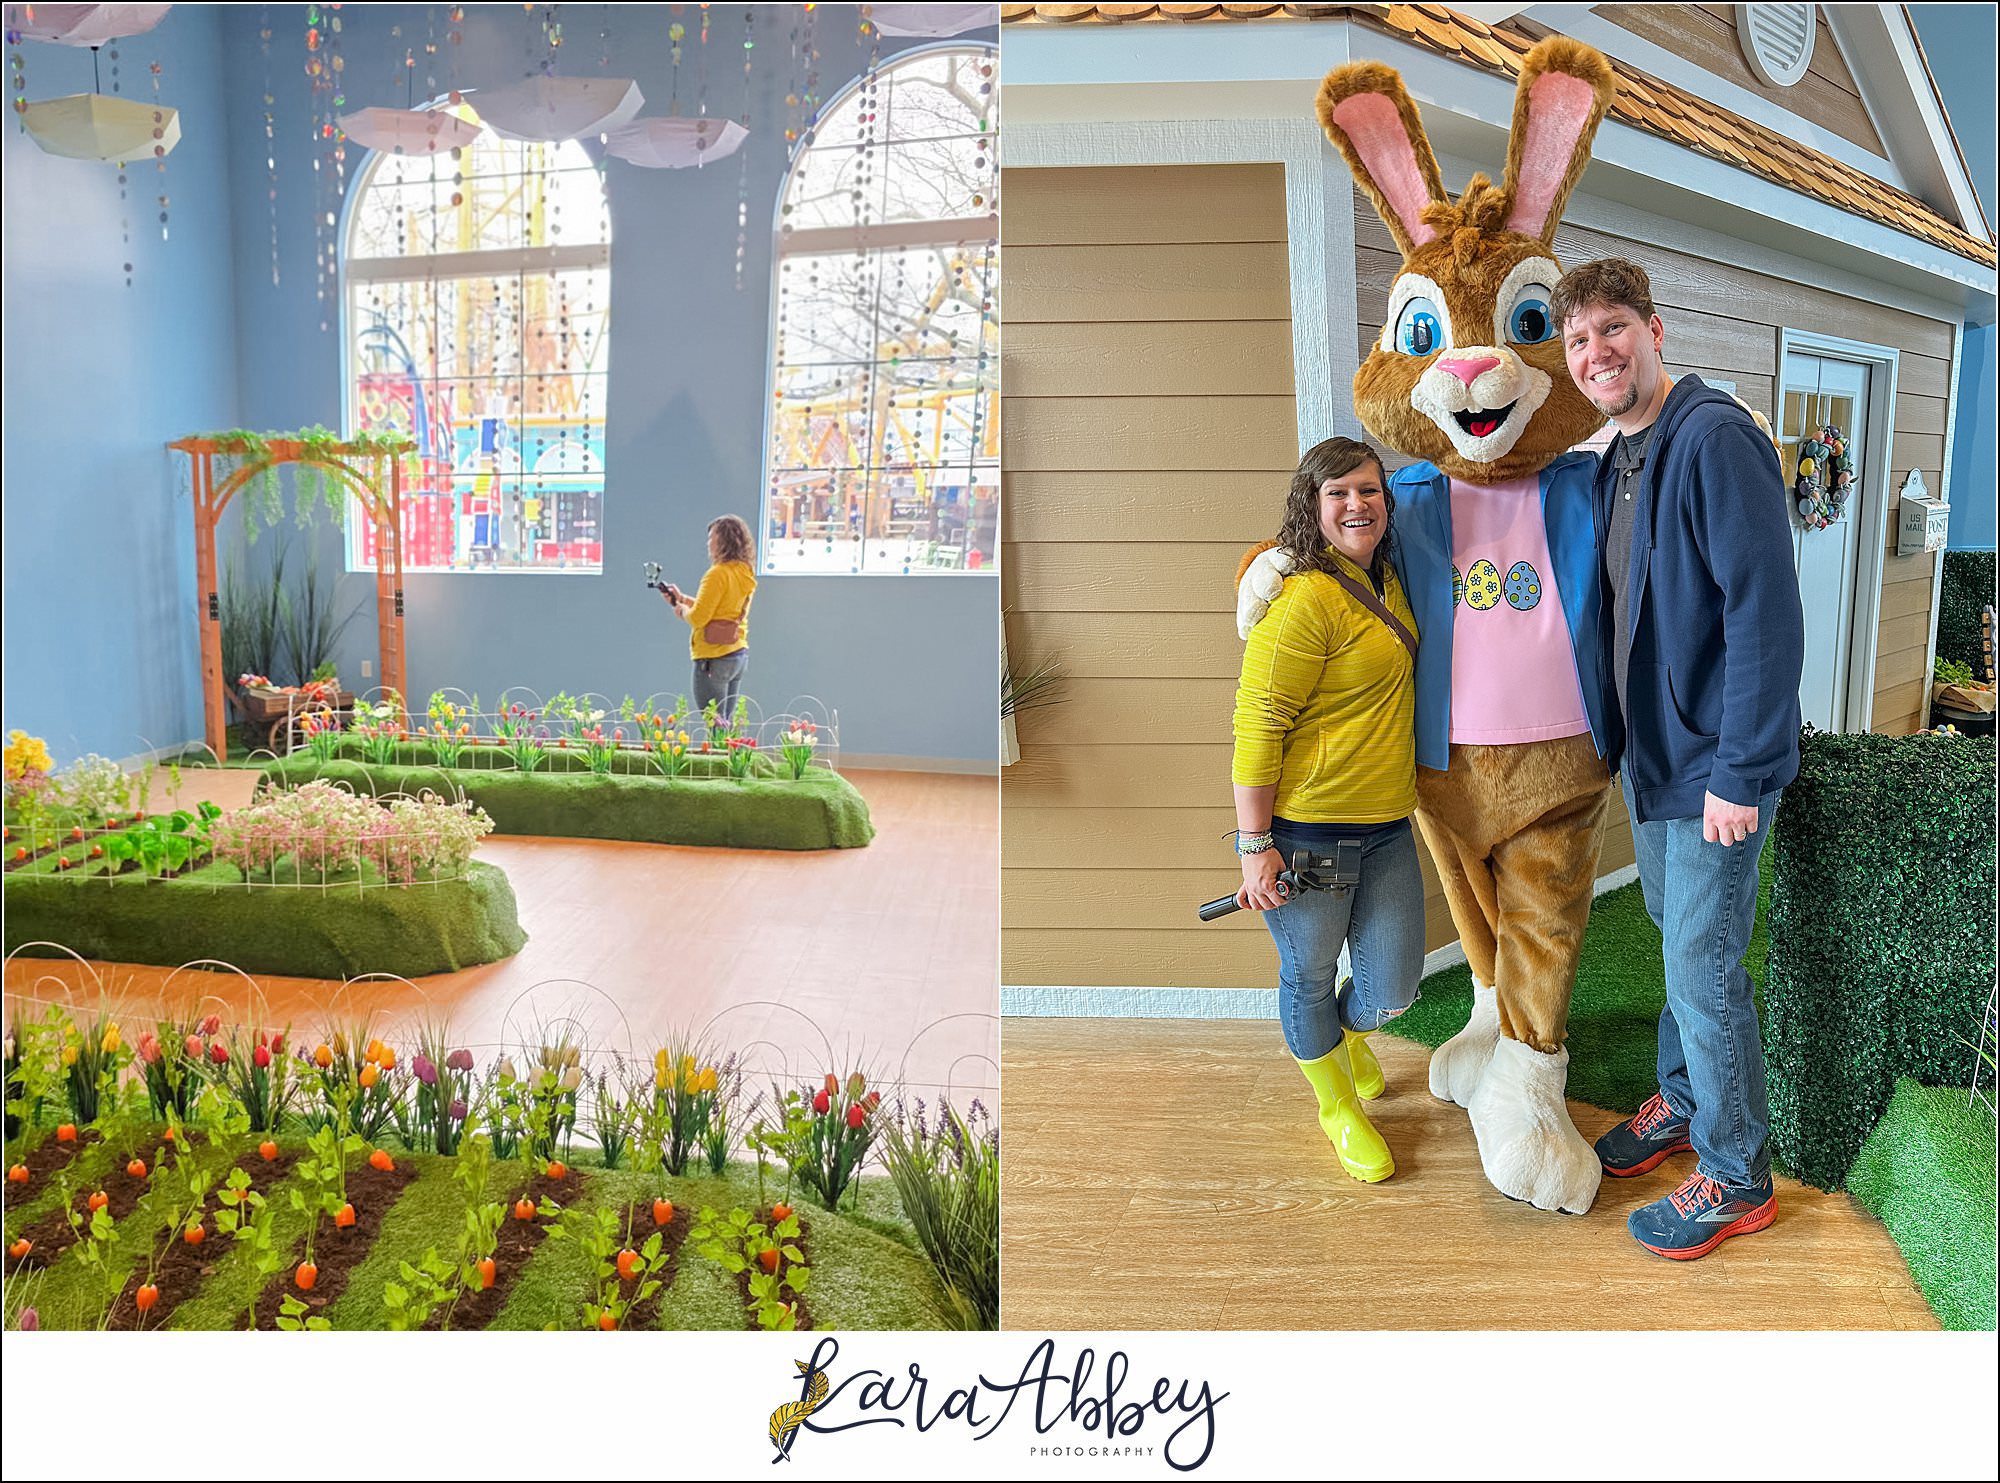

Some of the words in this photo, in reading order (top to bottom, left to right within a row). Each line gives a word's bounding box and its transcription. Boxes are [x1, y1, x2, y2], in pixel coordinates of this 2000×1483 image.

[1910, 513, 1921, 523] US
[1905, 523, 1925, 532] MAIL
[1928, 517, 1947, 535] POST
